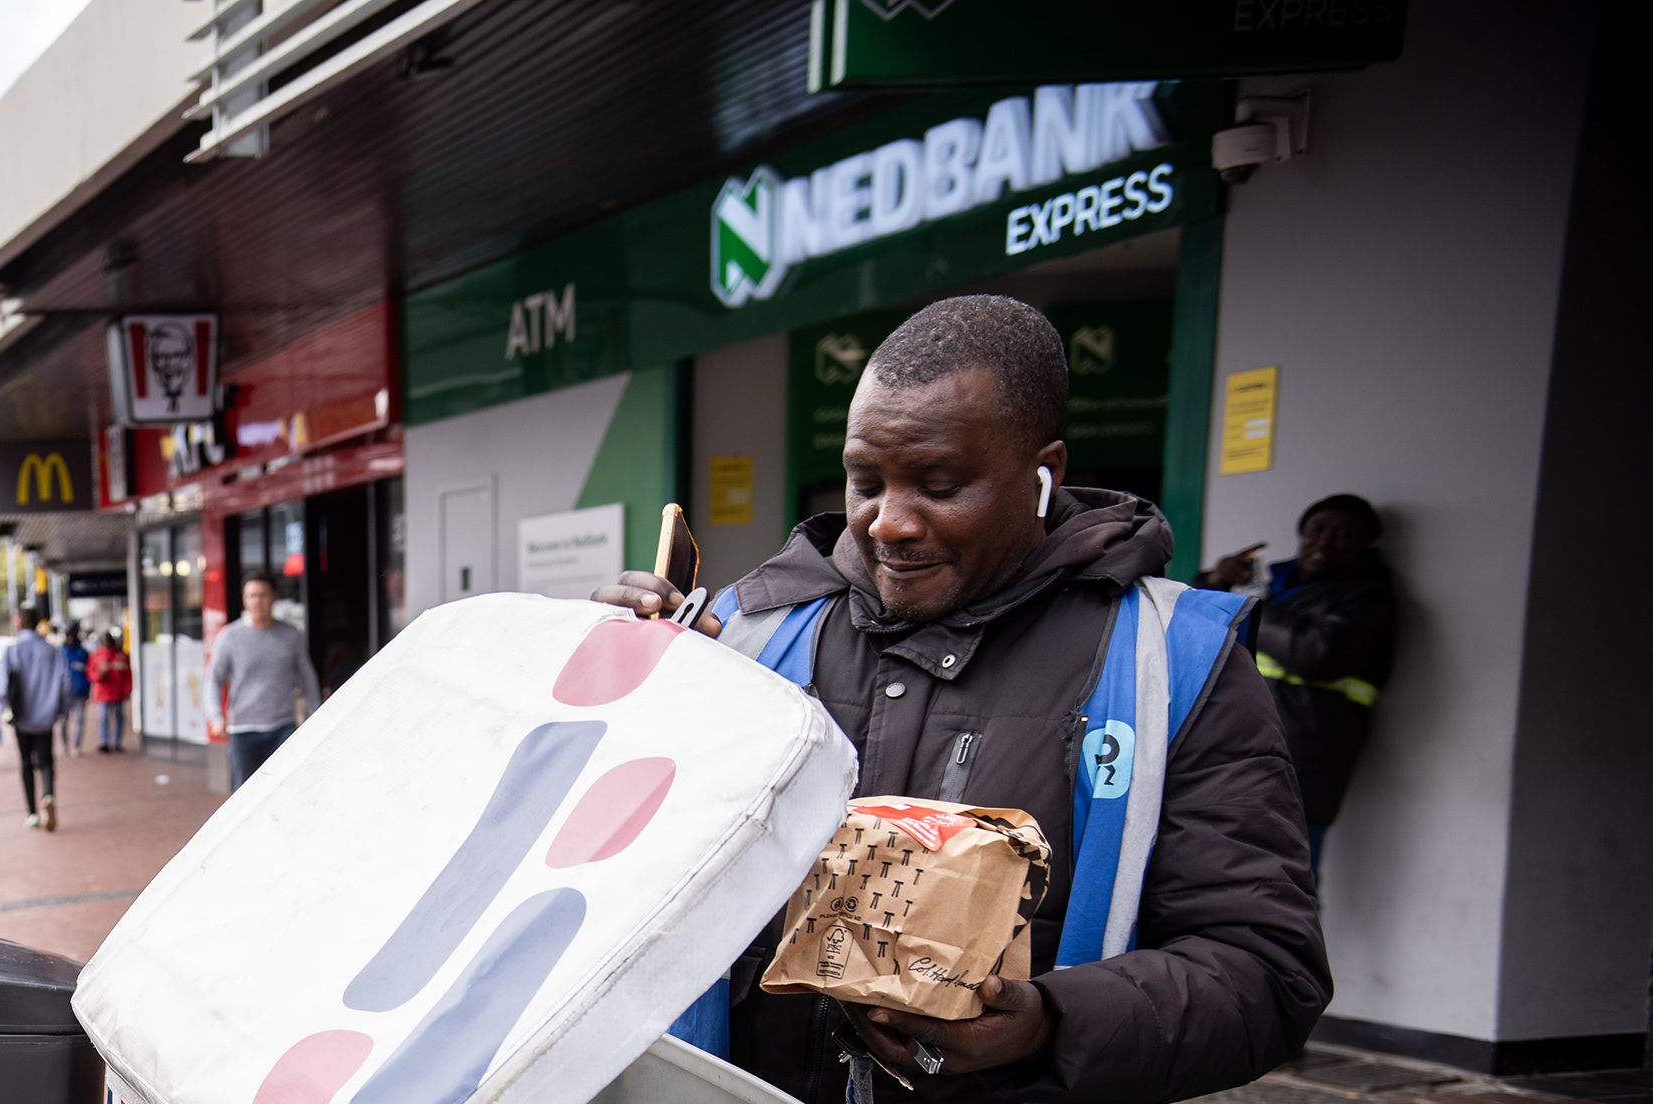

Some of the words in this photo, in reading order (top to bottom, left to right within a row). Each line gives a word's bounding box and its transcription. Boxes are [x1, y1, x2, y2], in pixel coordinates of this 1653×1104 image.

[776, 81, 1175, 263] NEDBANK
[1006, 163, 1174, 256] EXPRESS
[505, 282, 576, 361] ATM
